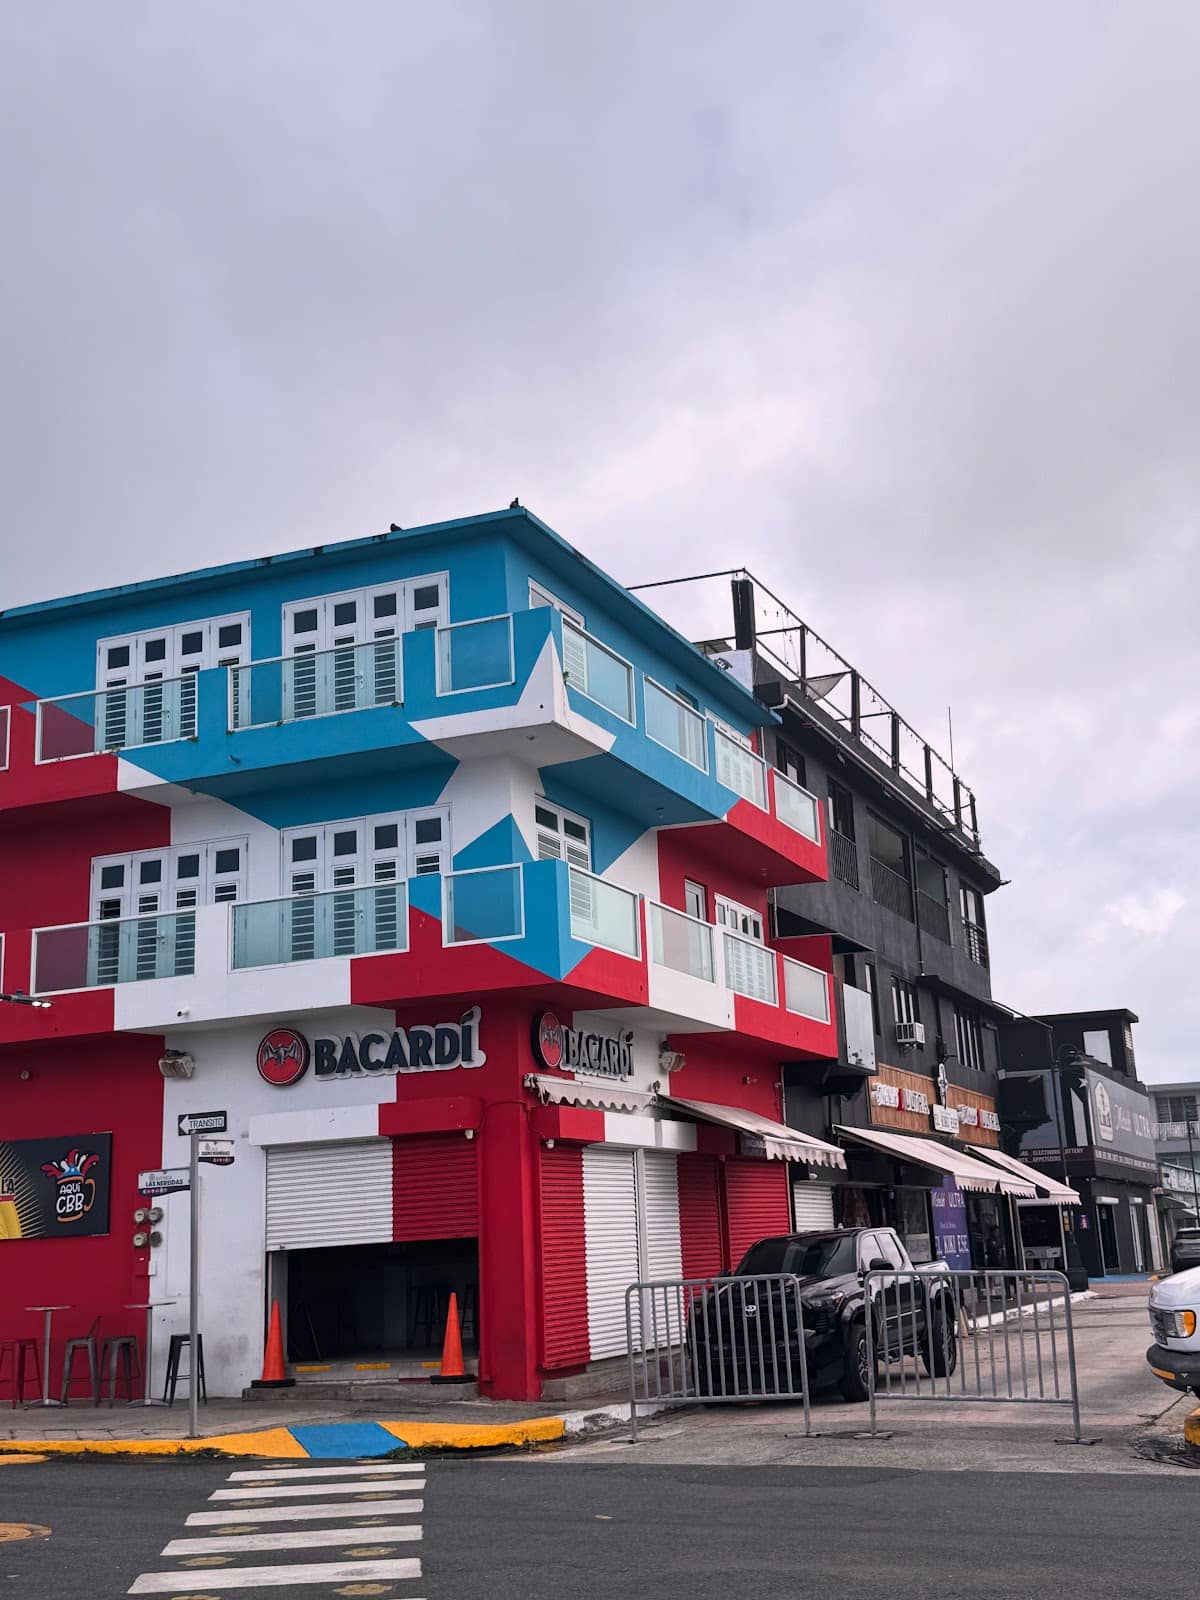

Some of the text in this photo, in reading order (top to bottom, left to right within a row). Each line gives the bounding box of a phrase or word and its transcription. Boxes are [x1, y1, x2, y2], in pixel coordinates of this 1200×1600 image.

[314, 1009, 475, 1076] BACARDÍ
[562, 1028, 635, 1077] BACARDÍ
[189, 1117, 224, 1129] TRANSITO
[145, 1179, 156, 1187] LAS
[56, 1193, 84, 1213] CBB
